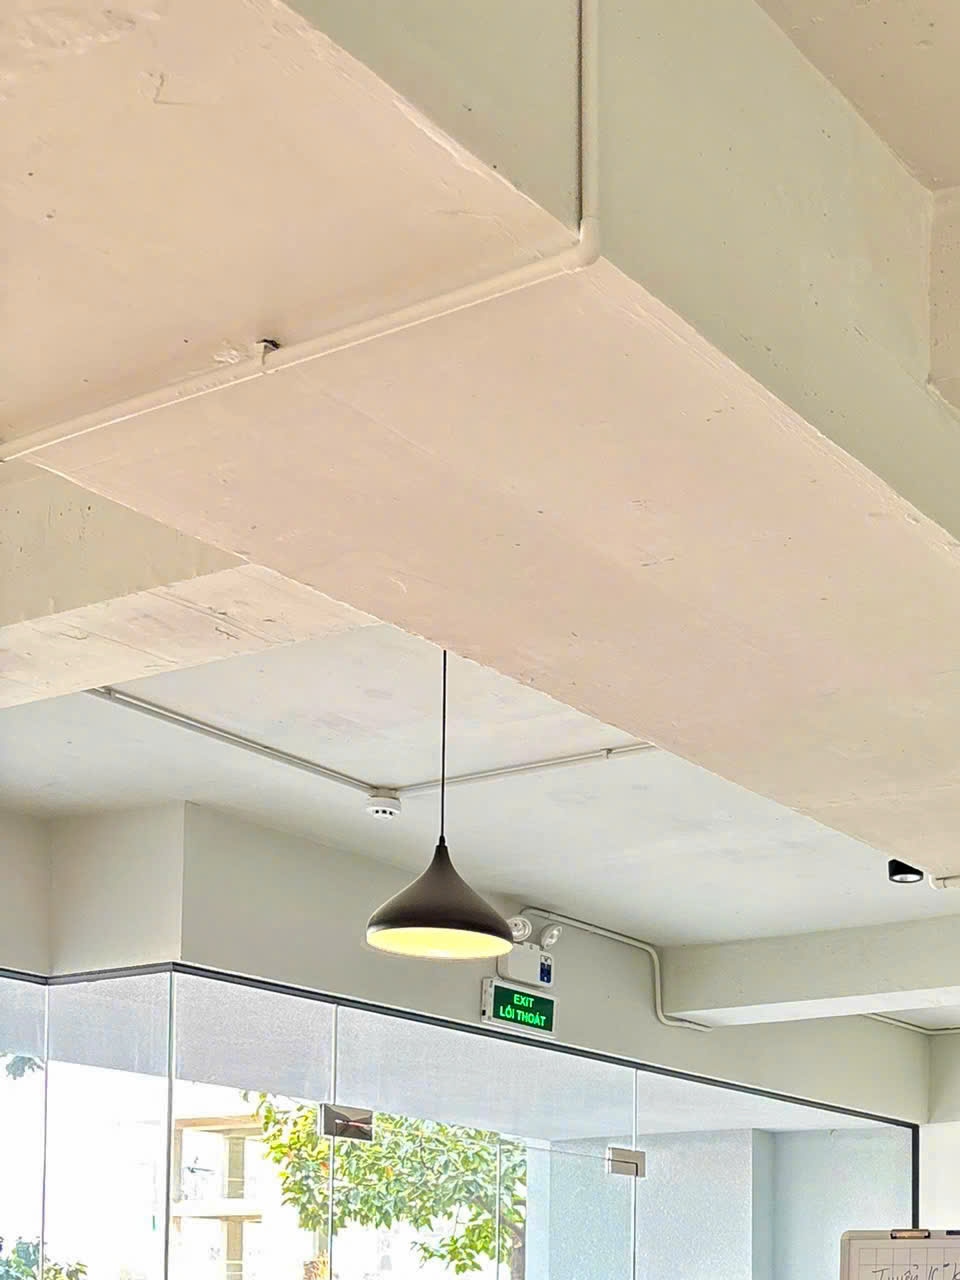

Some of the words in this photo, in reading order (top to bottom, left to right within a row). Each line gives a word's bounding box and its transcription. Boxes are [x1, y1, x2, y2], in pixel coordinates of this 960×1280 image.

[513, 993, 534, 1008] EXIT
[500, 1005, 515, 1019] LỐI
[516, 1010, 546, 1026] THOÁT
